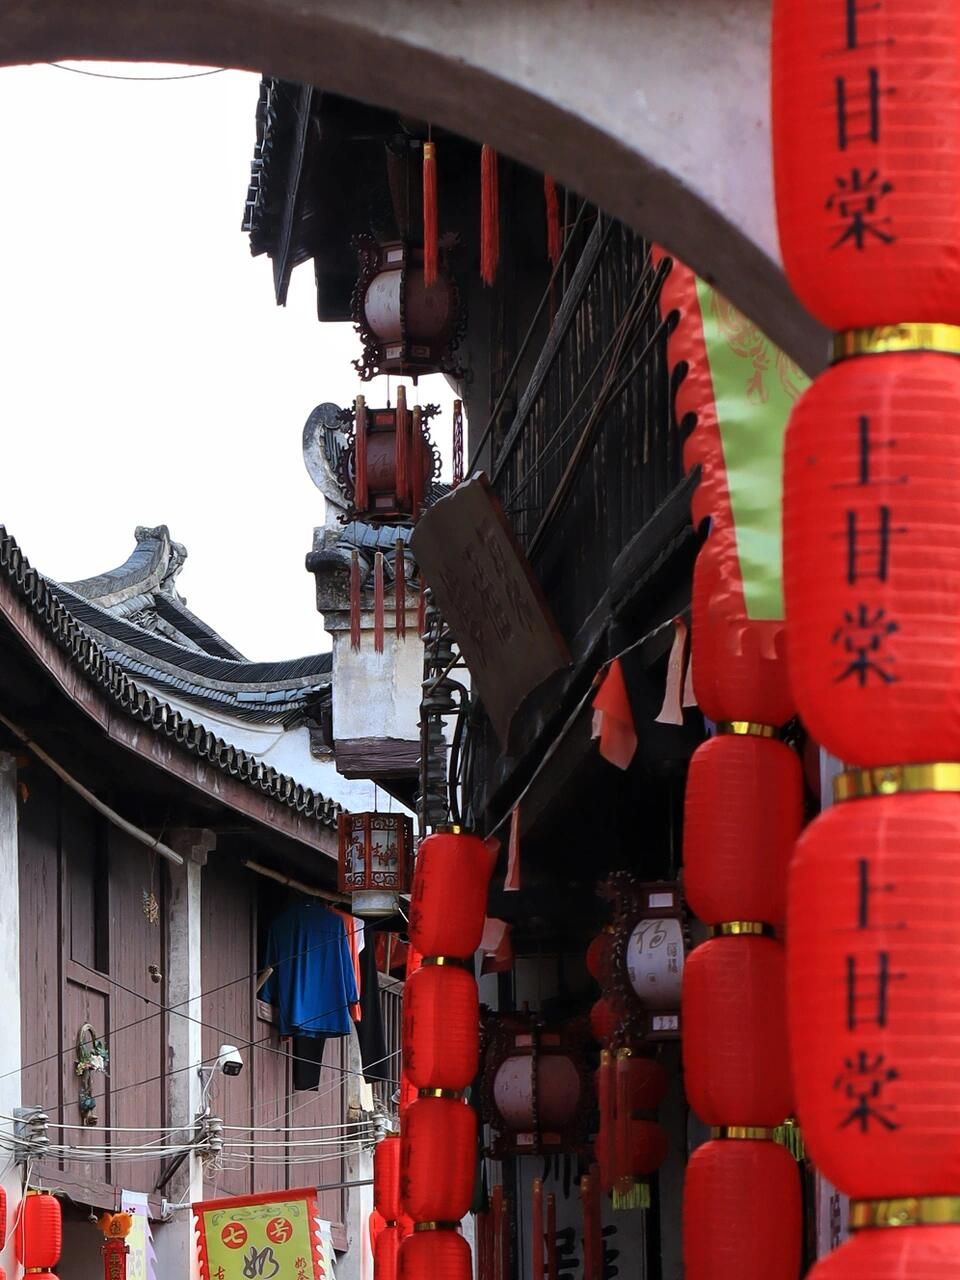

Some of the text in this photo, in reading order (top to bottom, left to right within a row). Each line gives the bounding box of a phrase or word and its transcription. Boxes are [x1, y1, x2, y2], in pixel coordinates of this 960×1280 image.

[829, 416, 908, 688] 上甘棠
[833, 857, 907, 1132] 上甘棠
[223, 1218, 290, 1244] 七号
